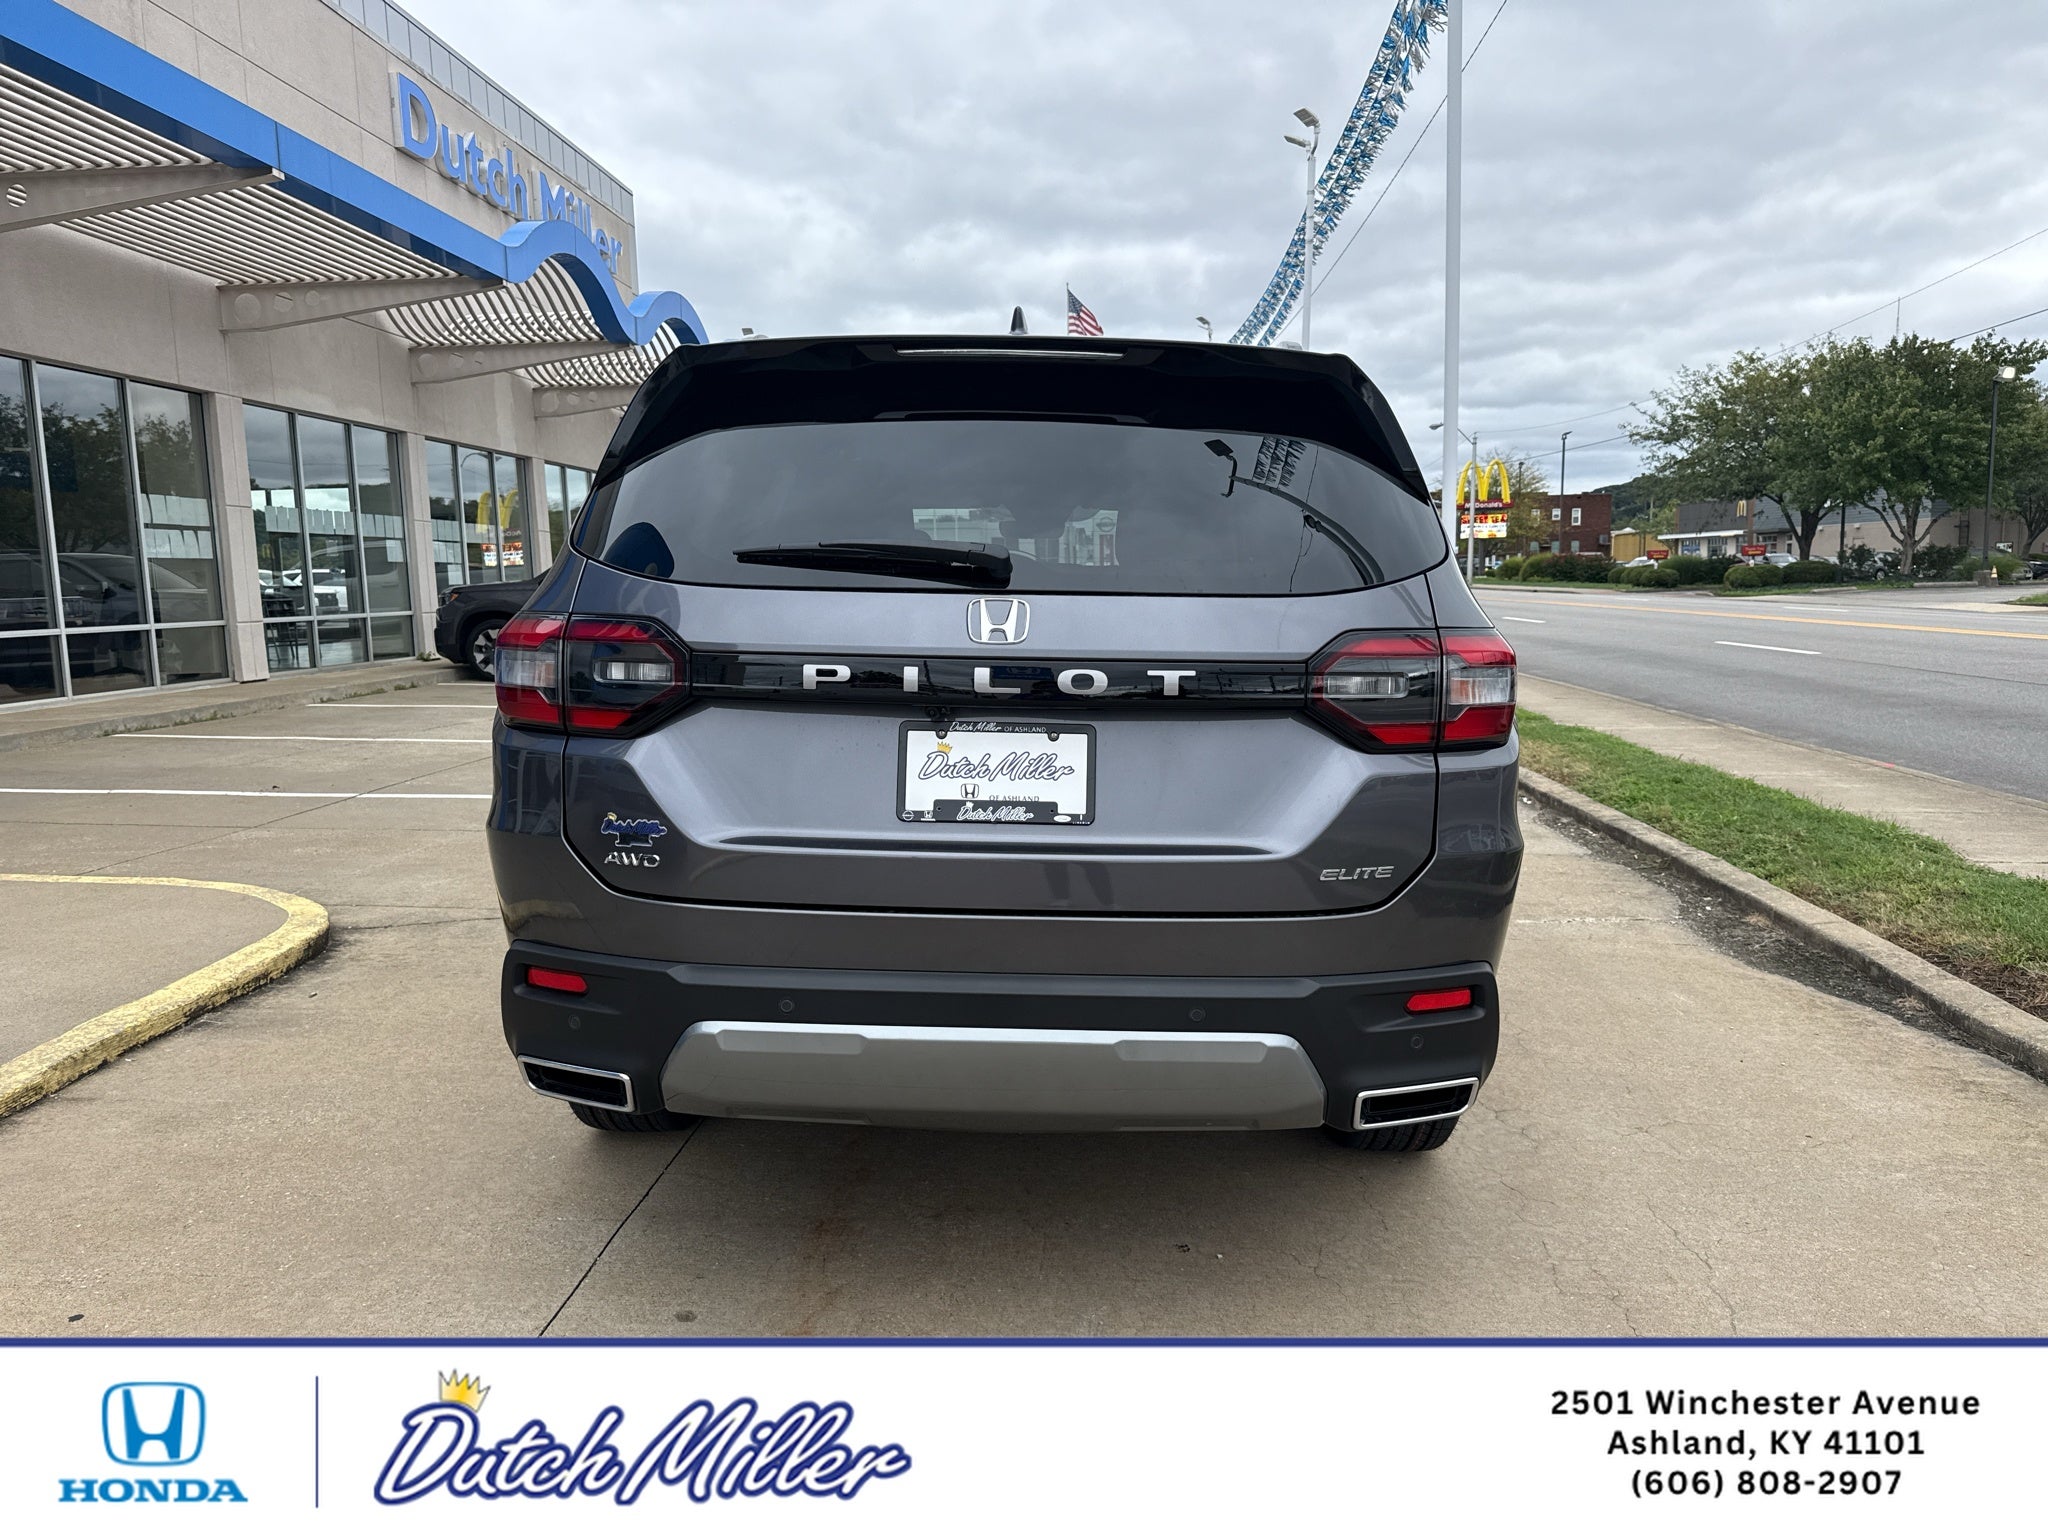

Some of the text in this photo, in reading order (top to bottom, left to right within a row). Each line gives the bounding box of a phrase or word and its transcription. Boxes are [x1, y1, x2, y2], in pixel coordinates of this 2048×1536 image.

[392, 72, 623, 275] Dutch Miller
[1461, 515, 1488, 524] SEET
[802, 664, 1197, 696] PILOT
[949, 721, 974, 732] Dutch
[973, 721, 1002, 732] Miller
[918, 751, 1075, 781] Dutch Miller
[1002, 794, 1040, 802] ASHLAND
[956, 805, 1034, 822] Dutch Miller
[603, 851, 661, 868] AWD
[1319, 865, 1395, 881] ELITE
